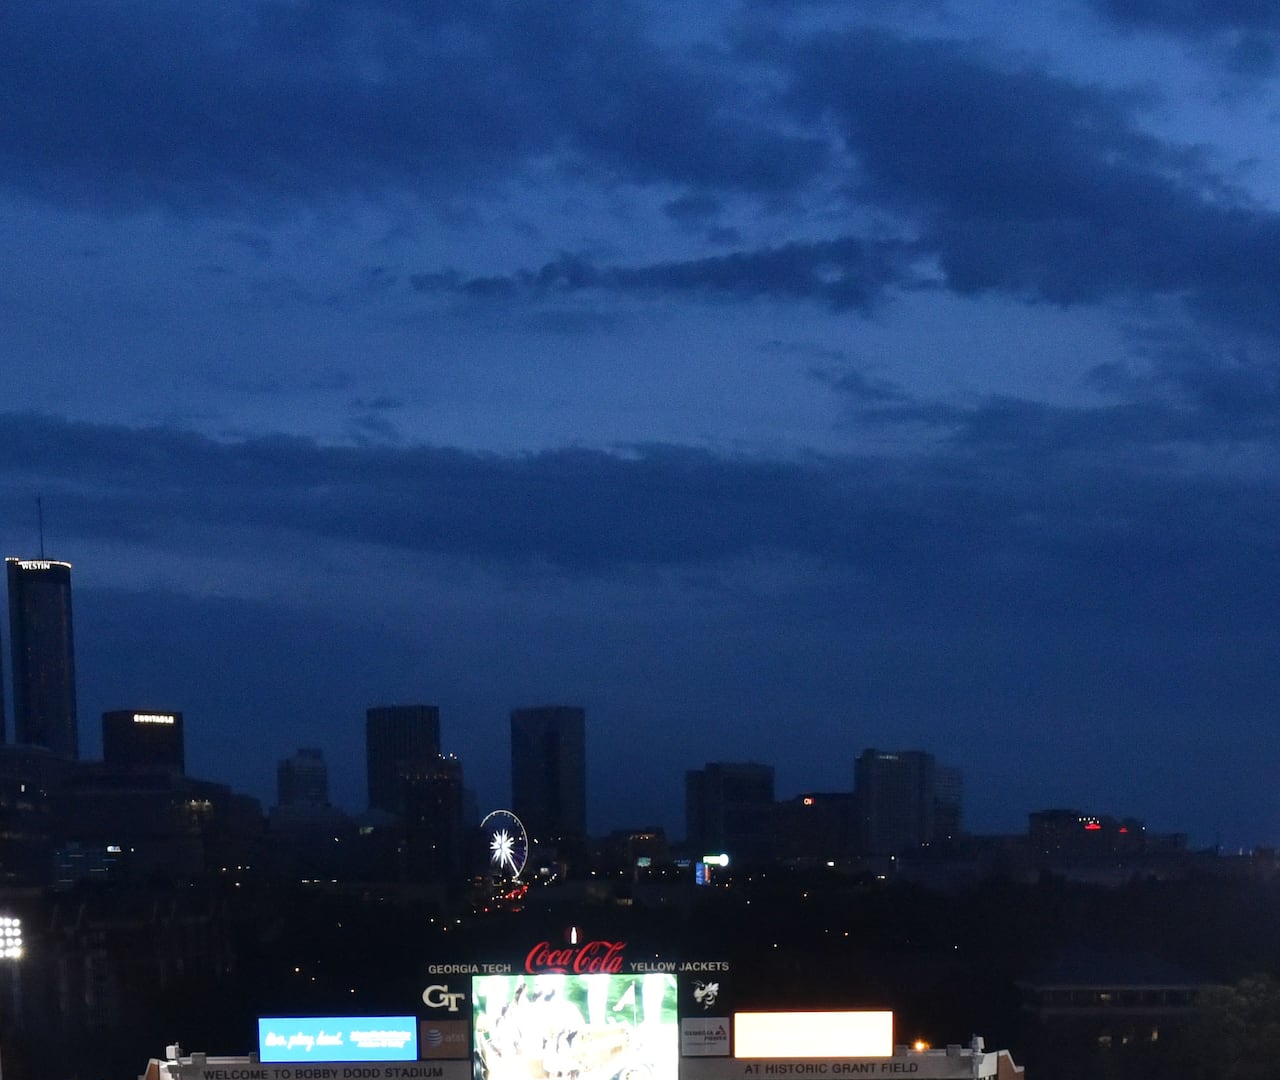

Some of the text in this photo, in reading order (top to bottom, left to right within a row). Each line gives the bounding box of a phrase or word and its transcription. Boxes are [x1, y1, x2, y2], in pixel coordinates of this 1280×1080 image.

[21, 561, 51, 570] WESTIN
[428, 963, 512, 975] GEORGIA TECH
[629, 961, 730, 972] YELLOW JACKETS
[422, 984, 466, 1012] GT
[203, 1067, 443, 1080] WELCOME TO BOBBY DODD STADIUM
[744, 1062, 919, 1075] AT HISTORIC GRANT FIELD
